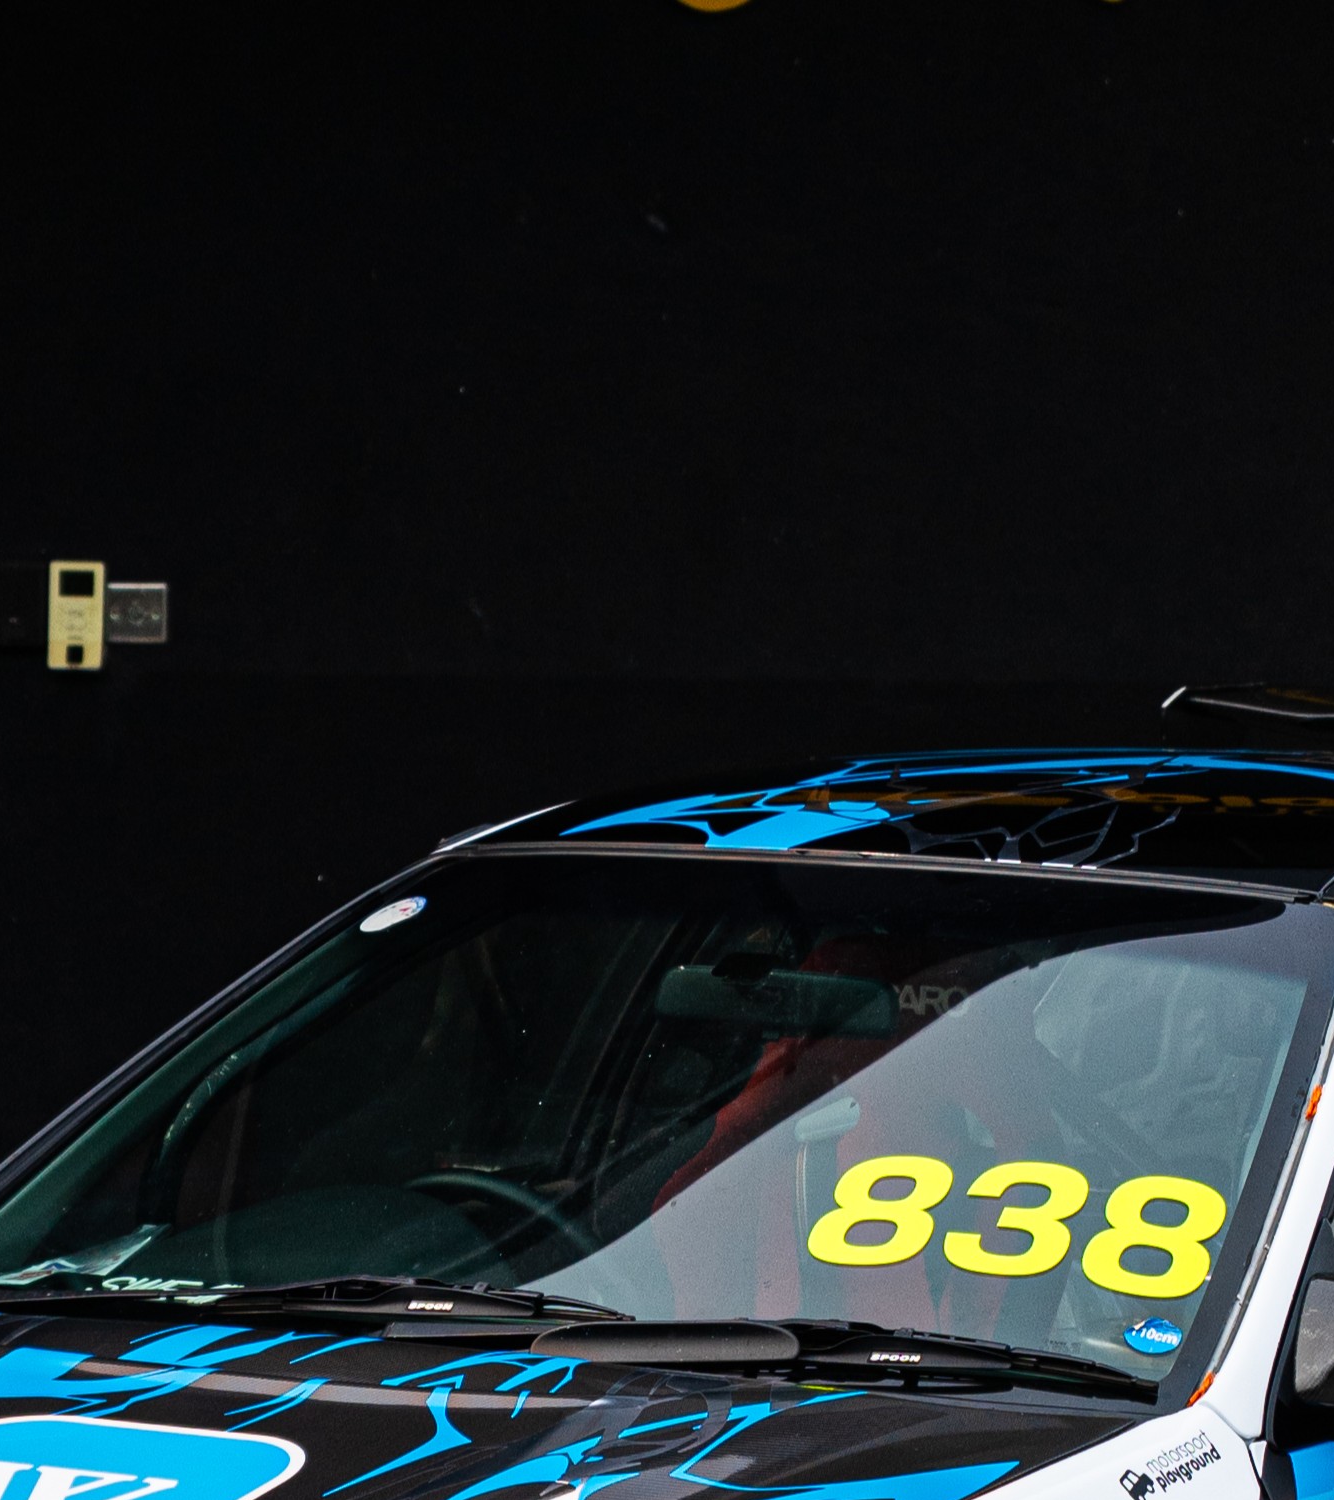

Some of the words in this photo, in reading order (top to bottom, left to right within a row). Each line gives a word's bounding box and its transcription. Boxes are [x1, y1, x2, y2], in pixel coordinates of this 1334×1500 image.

[807, 1154, 1227, 1299] 838
[407, 1301, 454, 1313] SPOON
[869, 1352, 922, 1364] SPOON
[1145, 1430, 1213, 1474] motorsport
[1155, 1441, 1222, 1492] playground
